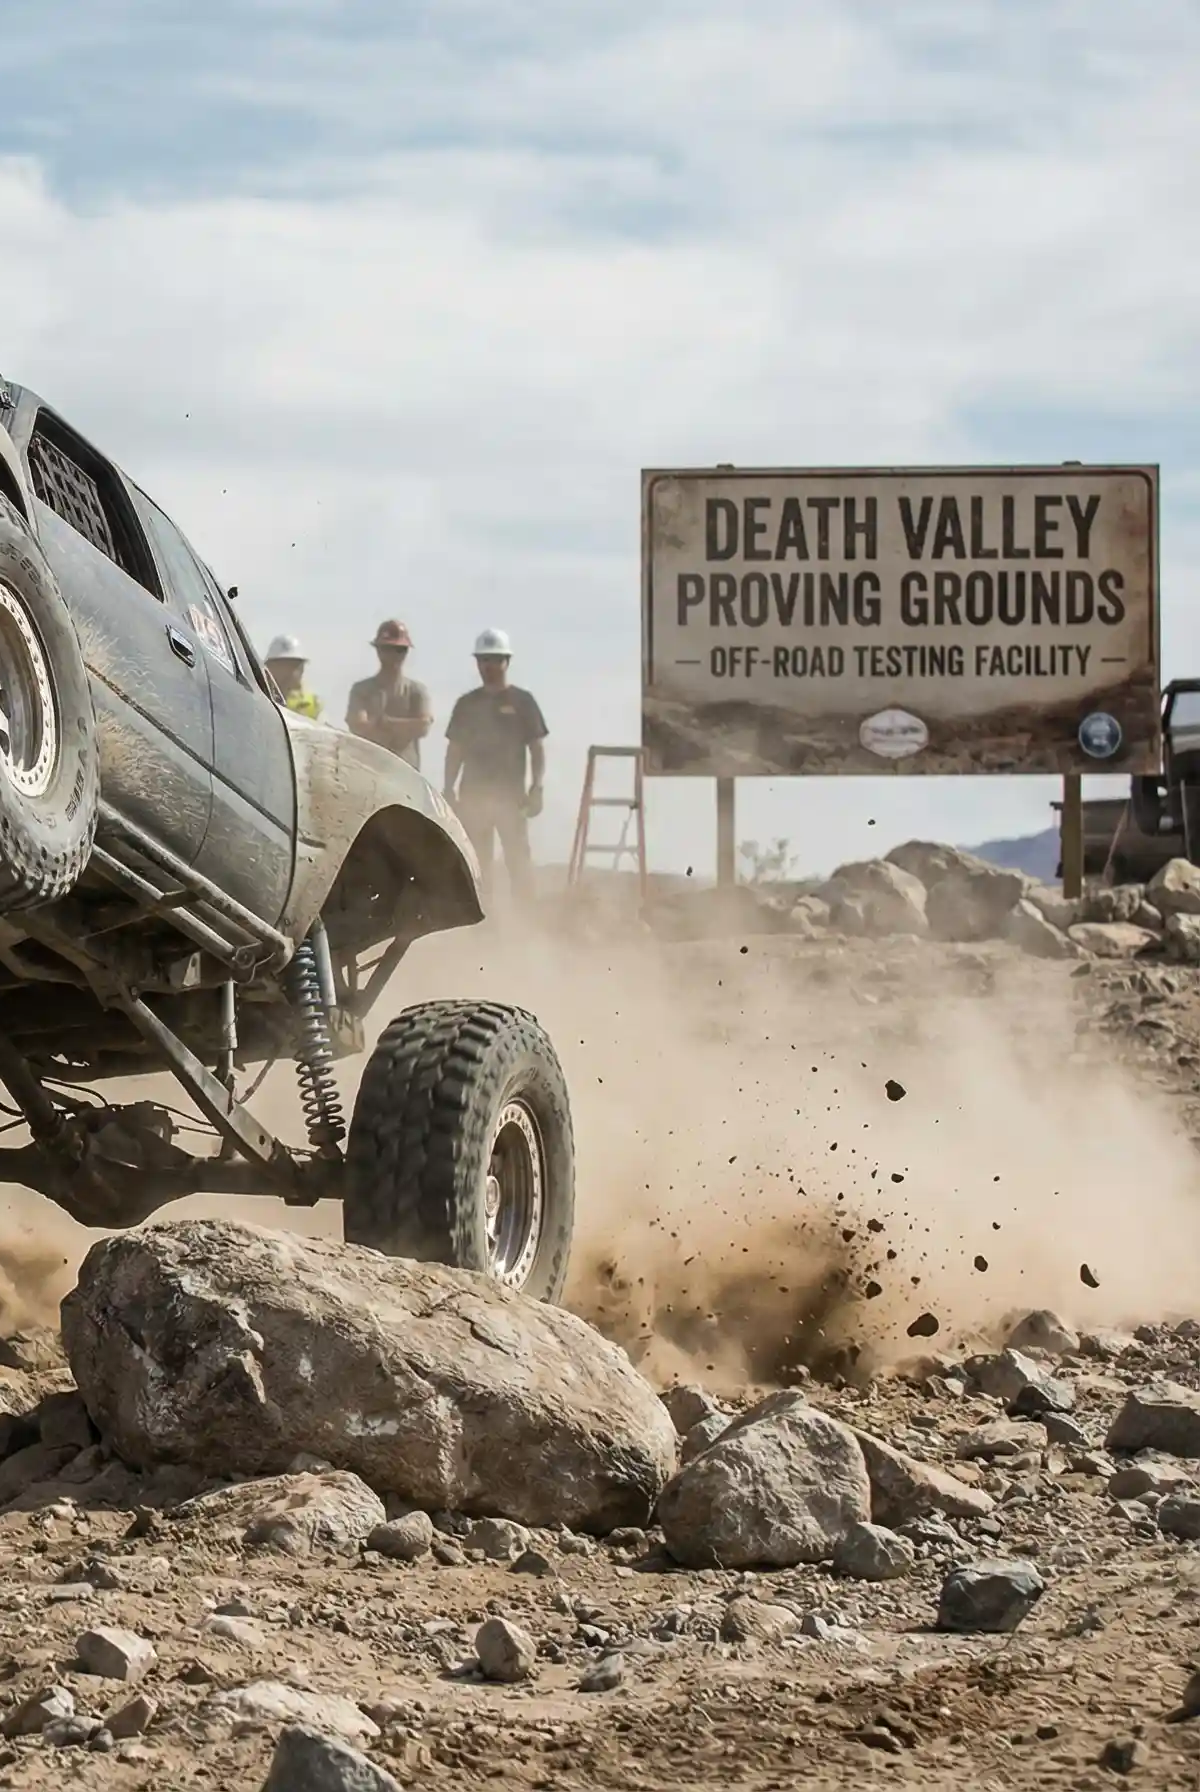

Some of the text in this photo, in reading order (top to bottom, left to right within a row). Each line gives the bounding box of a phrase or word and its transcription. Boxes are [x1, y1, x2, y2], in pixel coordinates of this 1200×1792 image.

[705, 494, 1101, 561] DEATH VALLEY
[677, 570, 1125, 627] PROVING GROUNDS
[710, 645, 1091, 678] OFF-ROAD TESTING FACILITY
